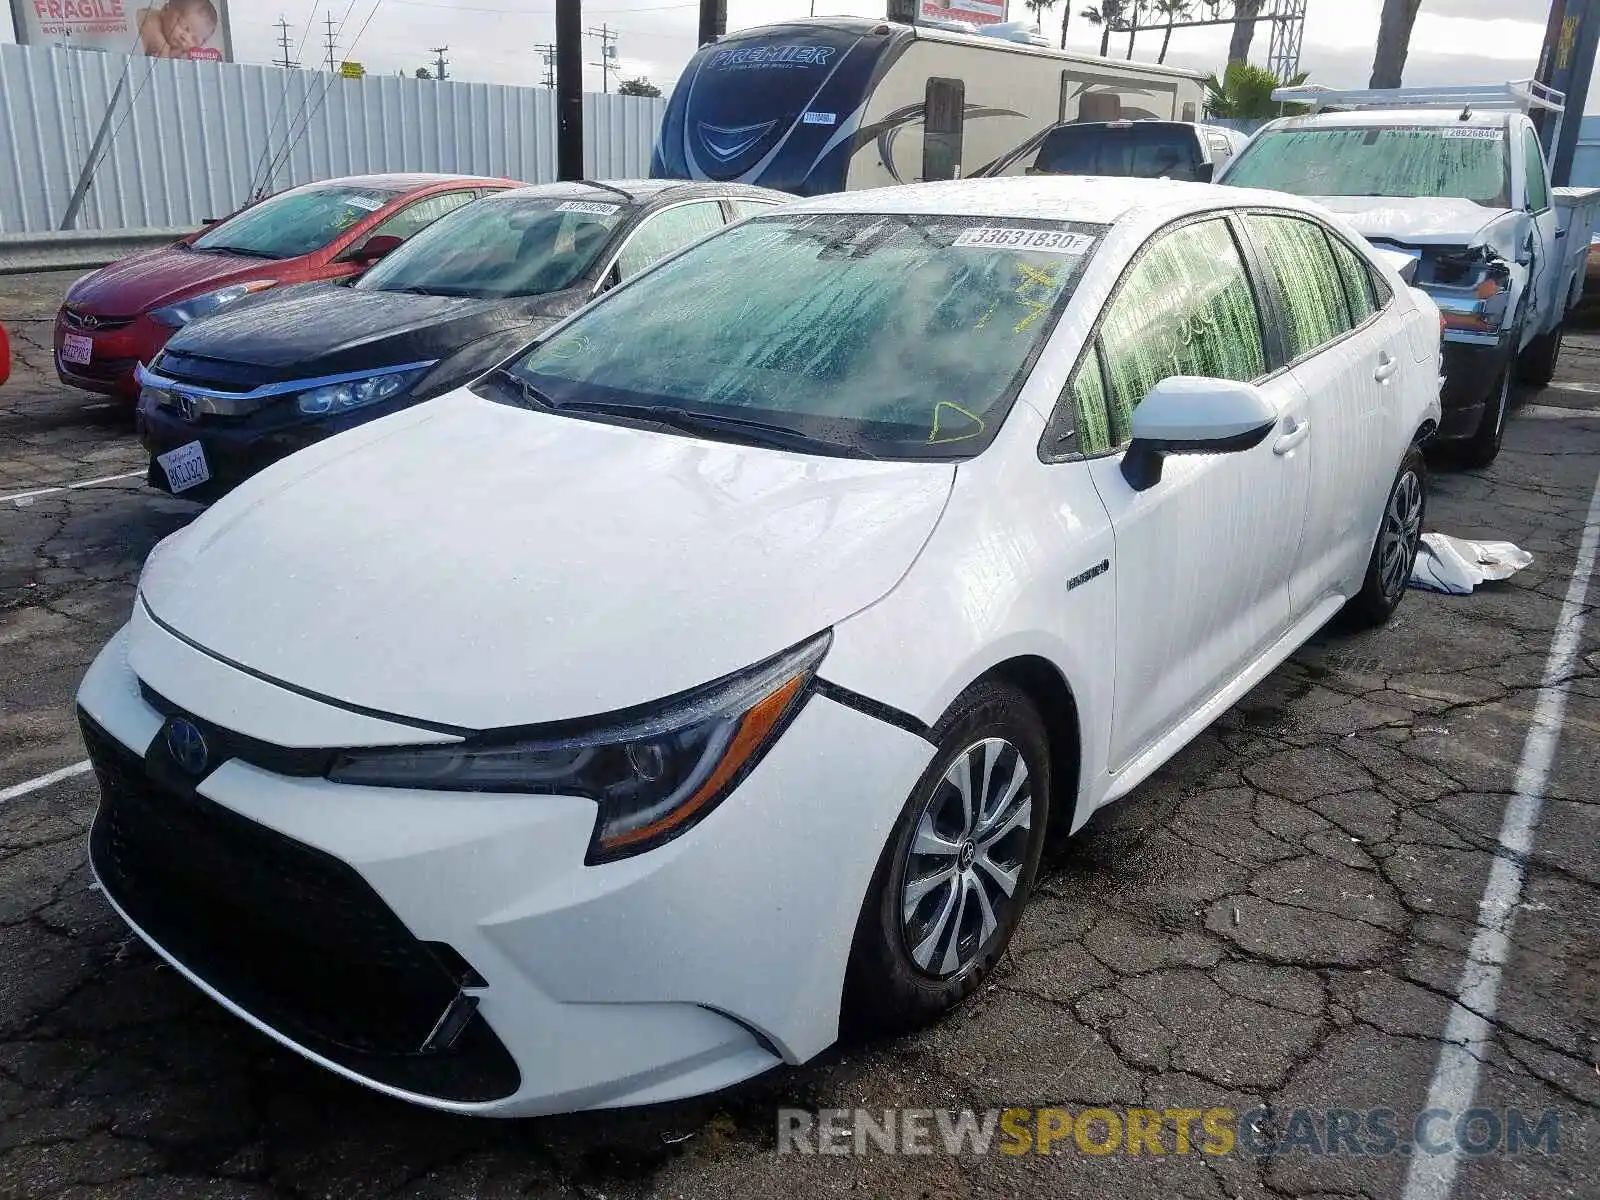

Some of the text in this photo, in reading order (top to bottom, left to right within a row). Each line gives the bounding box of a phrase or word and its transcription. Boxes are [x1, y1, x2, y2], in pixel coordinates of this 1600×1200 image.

[33, 0, 125, 18] FRAGILE
[707, 46, 836, 68] PREMIER
[971, 229, 1074, 249] 33631830
